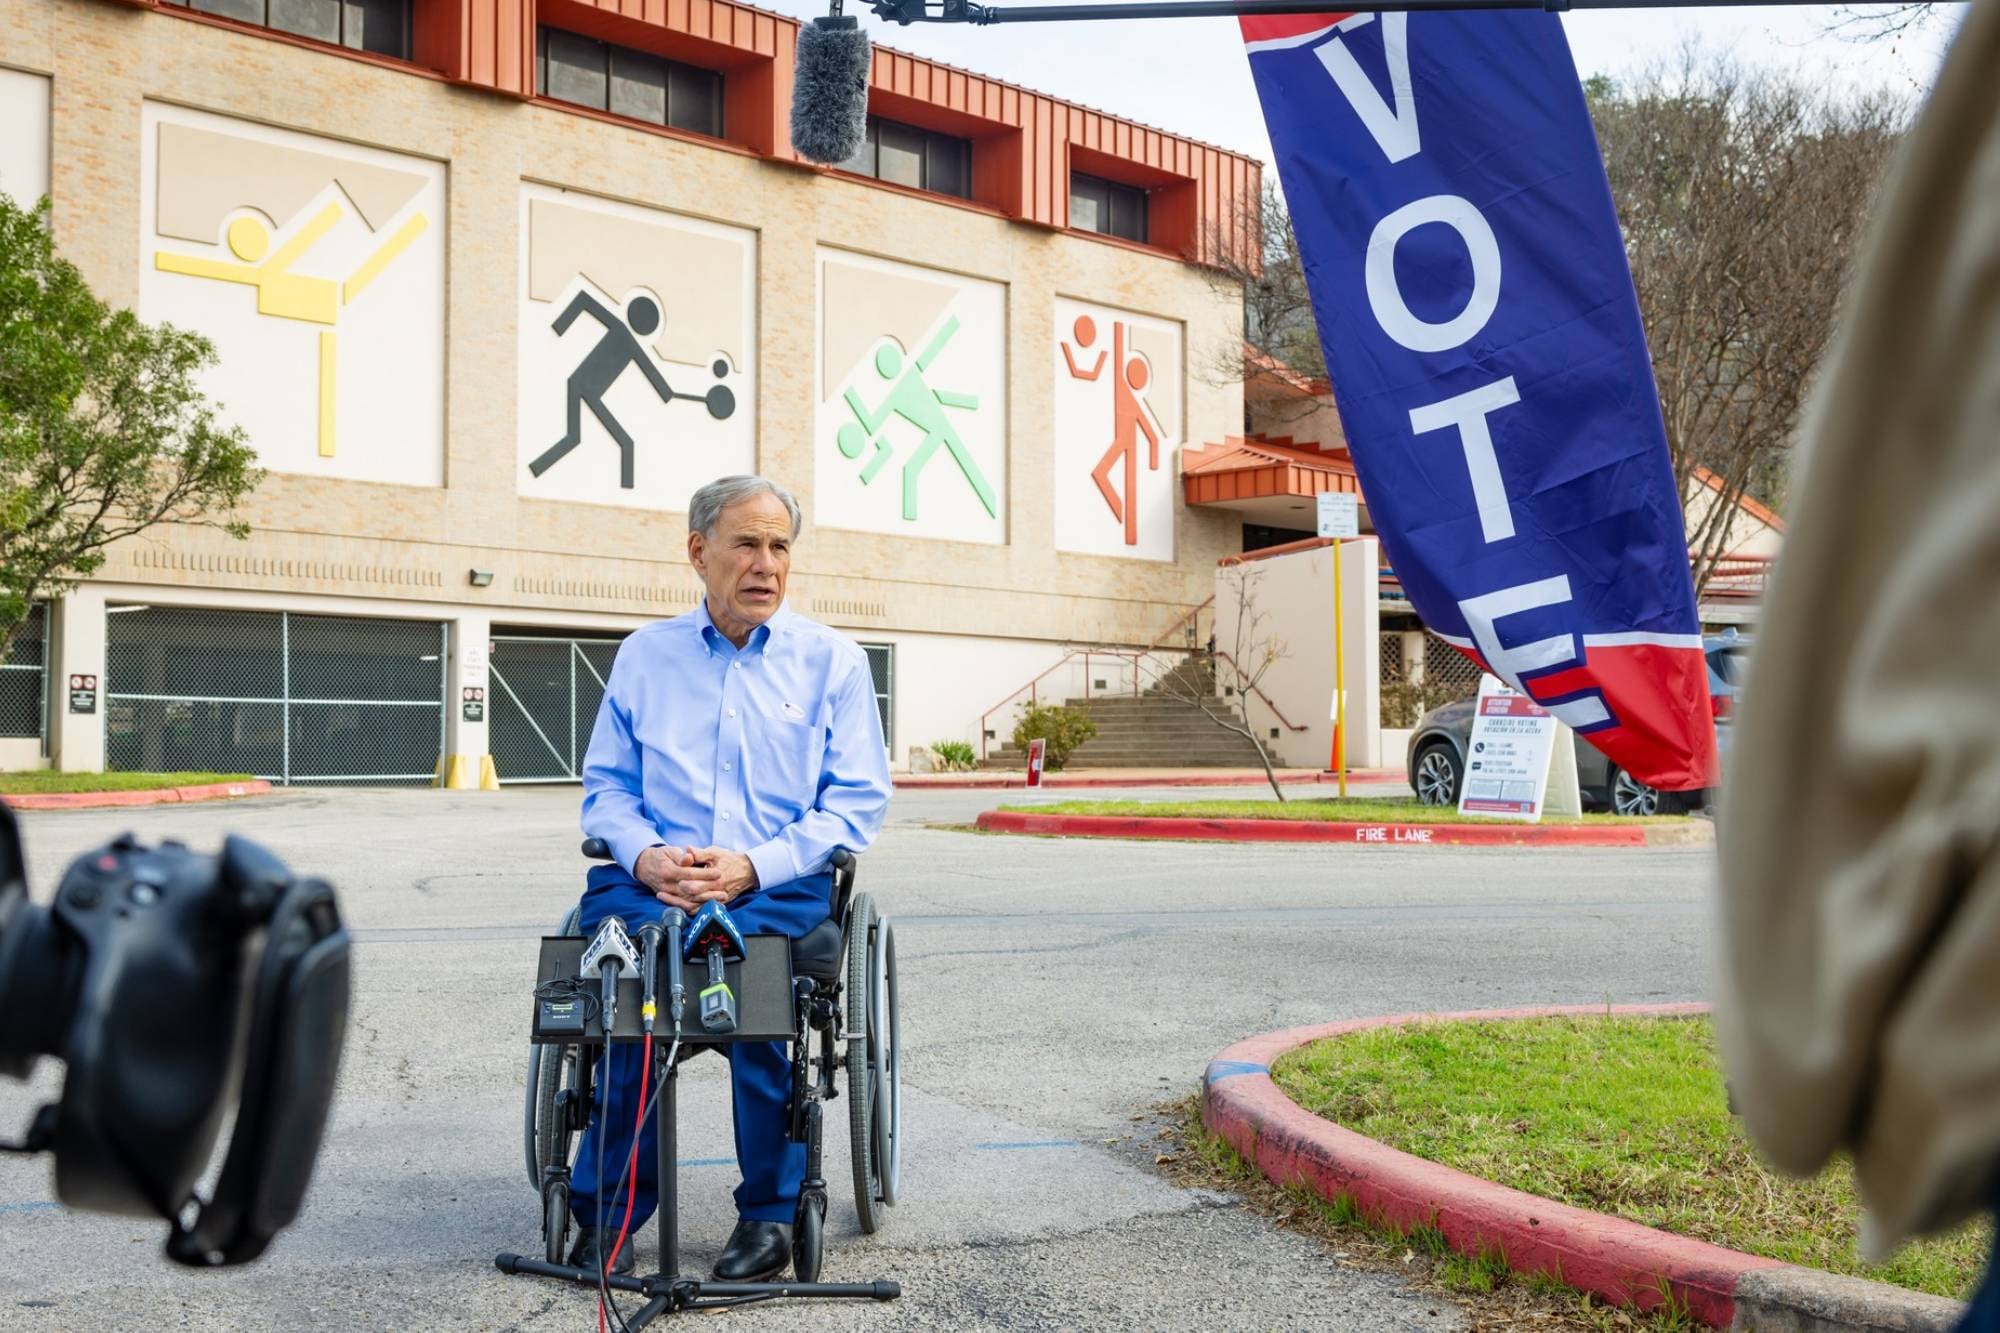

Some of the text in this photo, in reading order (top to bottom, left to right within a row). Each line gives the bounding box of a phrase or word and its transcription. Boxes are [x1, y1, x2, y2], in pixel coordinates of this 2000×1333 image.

[1313, 11, 1611, 727] VOTE
[1356, 828, 1432, 842] FIRE LANE
